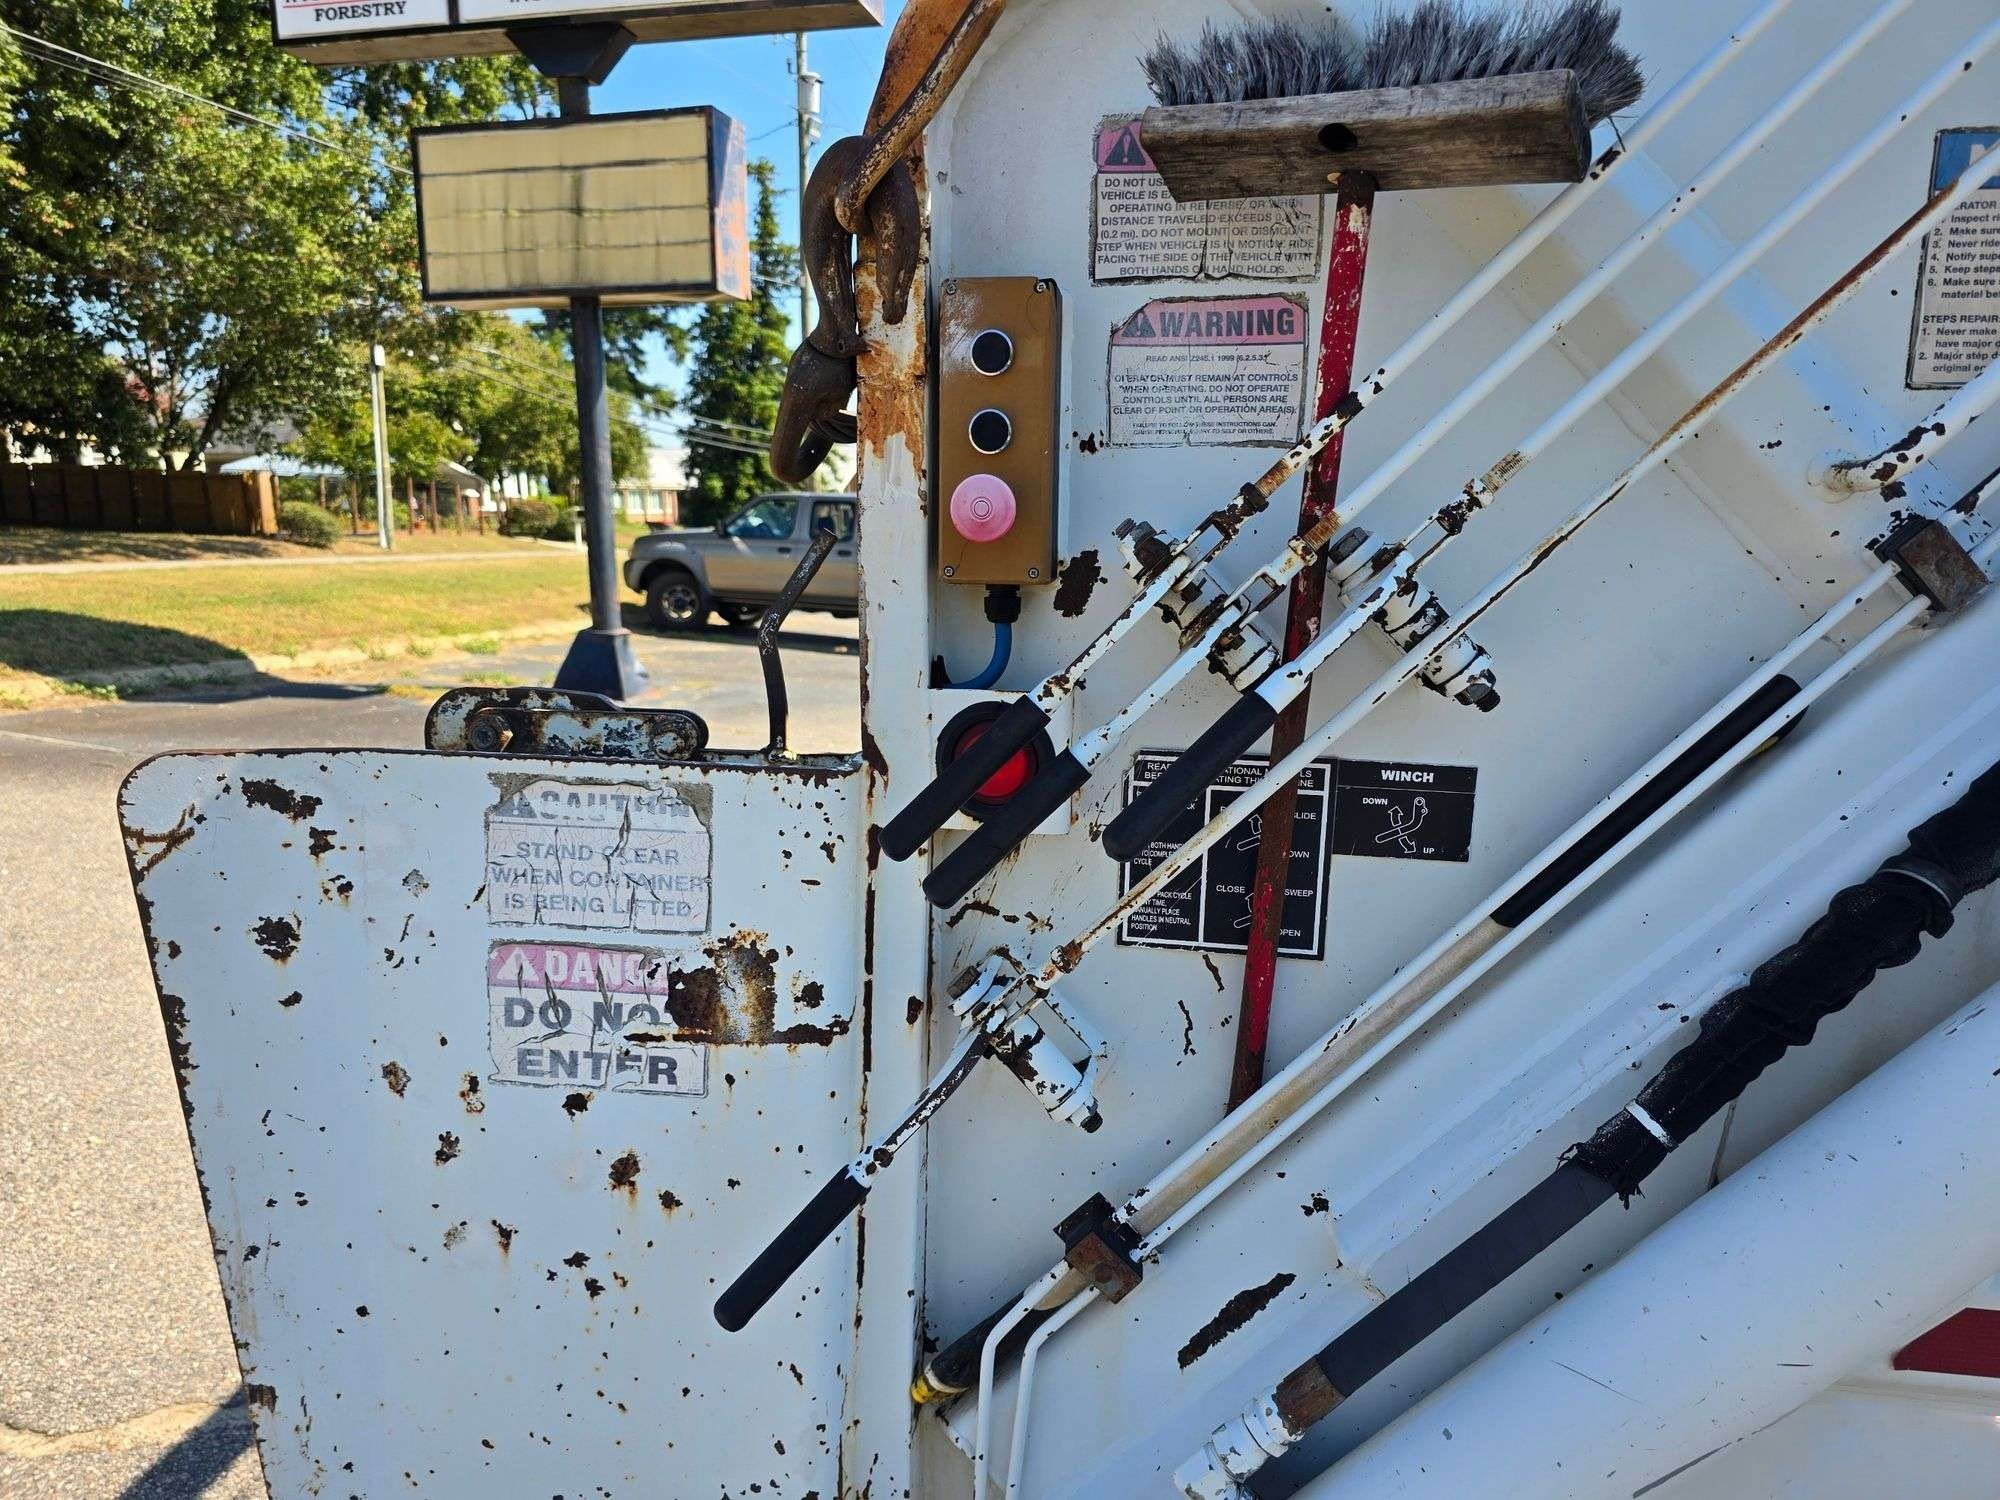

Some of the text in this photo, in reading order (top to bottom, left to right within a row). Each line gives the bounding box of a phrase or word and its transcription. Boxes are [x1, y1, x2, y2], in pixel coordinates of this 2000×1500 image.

[315, 1, 407, 22] FORESTRY
[1105, 179, 1119, 187] DO
[1123, 178, 1145, 187] NOT
[1101, 190, 1146, 200] VEHICLE
[1148, 190, 1158, 199] IS
[1109, 203, 1172, 213] OPERATING
[1175, 203, 1186, 211] IN
[1249, 200, 1265, 209] OR
[1955, 201, 1997, 210] RATOR
[1101, 216, 1155, 226] DISTANCE
[1158, 214, 1216, 225] TRAVELED
[1220, 213, 1271, 222] EXCEEDS
[1951, 215, 1989, 223] Inspect
[1100, 230, 1118, 240] (0.2
[1141, 229, 1158, 238] DO
[1161, 228, 1184, 237] NOT
[1186, 227, 1227, 237] MOUNT
[1231, 227, 1247, 236] OR
[1934, 228, 1943, 236] 2.
[1949, 227, 1977, 235] Make
[1096, 242, 1122, 252] STEP
[1124, 241, 1157, 251] WHEN
[1159, 240, 1206, 250] VEHICLE
[1210, 240, 1220, 249] IS
[1224, 240, 1235, 249] IN
[1288, 240, 1315, 249] RIDE
[1948, 240, 1978, 248] Never
[1097, 254, 1136, 264] FACING
[1138, 254, 1160, 263] THE
[1163, 253, 1188, 262] SIDE
[1209, 252, 1231, 261] THE
[1234, 252, 1281, 261] VEHICLE
[1284, 252, 1312, 261] WITH
[1946, 253, 1976, 262] Notify
[1119, 266, 1149, 276] BOTH
[1152, 266, 1189, 274] HANDS
[1212, 265, 1244, 274] HAND
[1929, 266, 1938, 274] 5.
[1944, 266, 1970, 275] Keep
[1943, 278, 1970, 286] Make
[1973, 278, 1996, 288] sure
[1941, 290, 1983, 299] material
[1159, 308, 1295, 337] WARNING
[1923, 315, 1957, 323] STEPS
[1922, 327, 1997, 336] 1. Never make
[1962, 340, 1993, 349] major
[1919, 352, 1928, 360] 2.
[1934, 352, 1963, 361] Major
[1966, 352, 1988, 360] step
[1932, 364, 1971, 373] original
[1115, 374, 1164, 382] OPERATOR
[1166, 374, 1192, 382] MUST
[1195, 374, 1230, 382] REMAIN
[1247, 373, 1298, 381] CONTROLS
[1120, 385, 1149, 393] WHEN
[1225, 384, 1245, 393] NOT
[1247, 384, 1290, 392] OPERATE
[1123, 395, 1288, 404] CONTROLS UNTIL ALL PERSONS ARE
[1113, 406, 1142, 415] CLEAR
[1144, 406, 1156, 414] OF
[1159, 406, 1186, 414] POINT
[1205, 405, 1257, 413] OPERATION
[1244, 776, 1260, 784] TH
[1381, 769, 1434, 783] WINCH
[1362, 797, 1388, 806] DOWN
[1150, 842, 1166, 850] BOTH
[516, 842, 679, 865] STAND CEAR
[1289, 850, 1310, 859] OWN
[1423, 847, 1435, 855] UP
[1133, 858, 1152, 866] CYCLE
[491, 867, 705, 892] WHEN CONTAINER
[1216, 884, 1246, 894] CLOSE
[1284, 888, 1314, 898] SWEEP
[1173, 891, 1192, 900] CYCLE
[504, 893, 692, 917] IS BEING LIFTED
[1132, 914, 1157, 923] HANDLES
[1165, 916, 1191, 925] NEUTRAL
[1130, 922, 1157, 930] POSITION
[545, 950, 660, 986] DANG
[504, 997, 662, 1033] DO NO
[517, 1047, 678, 1086] ENTER
